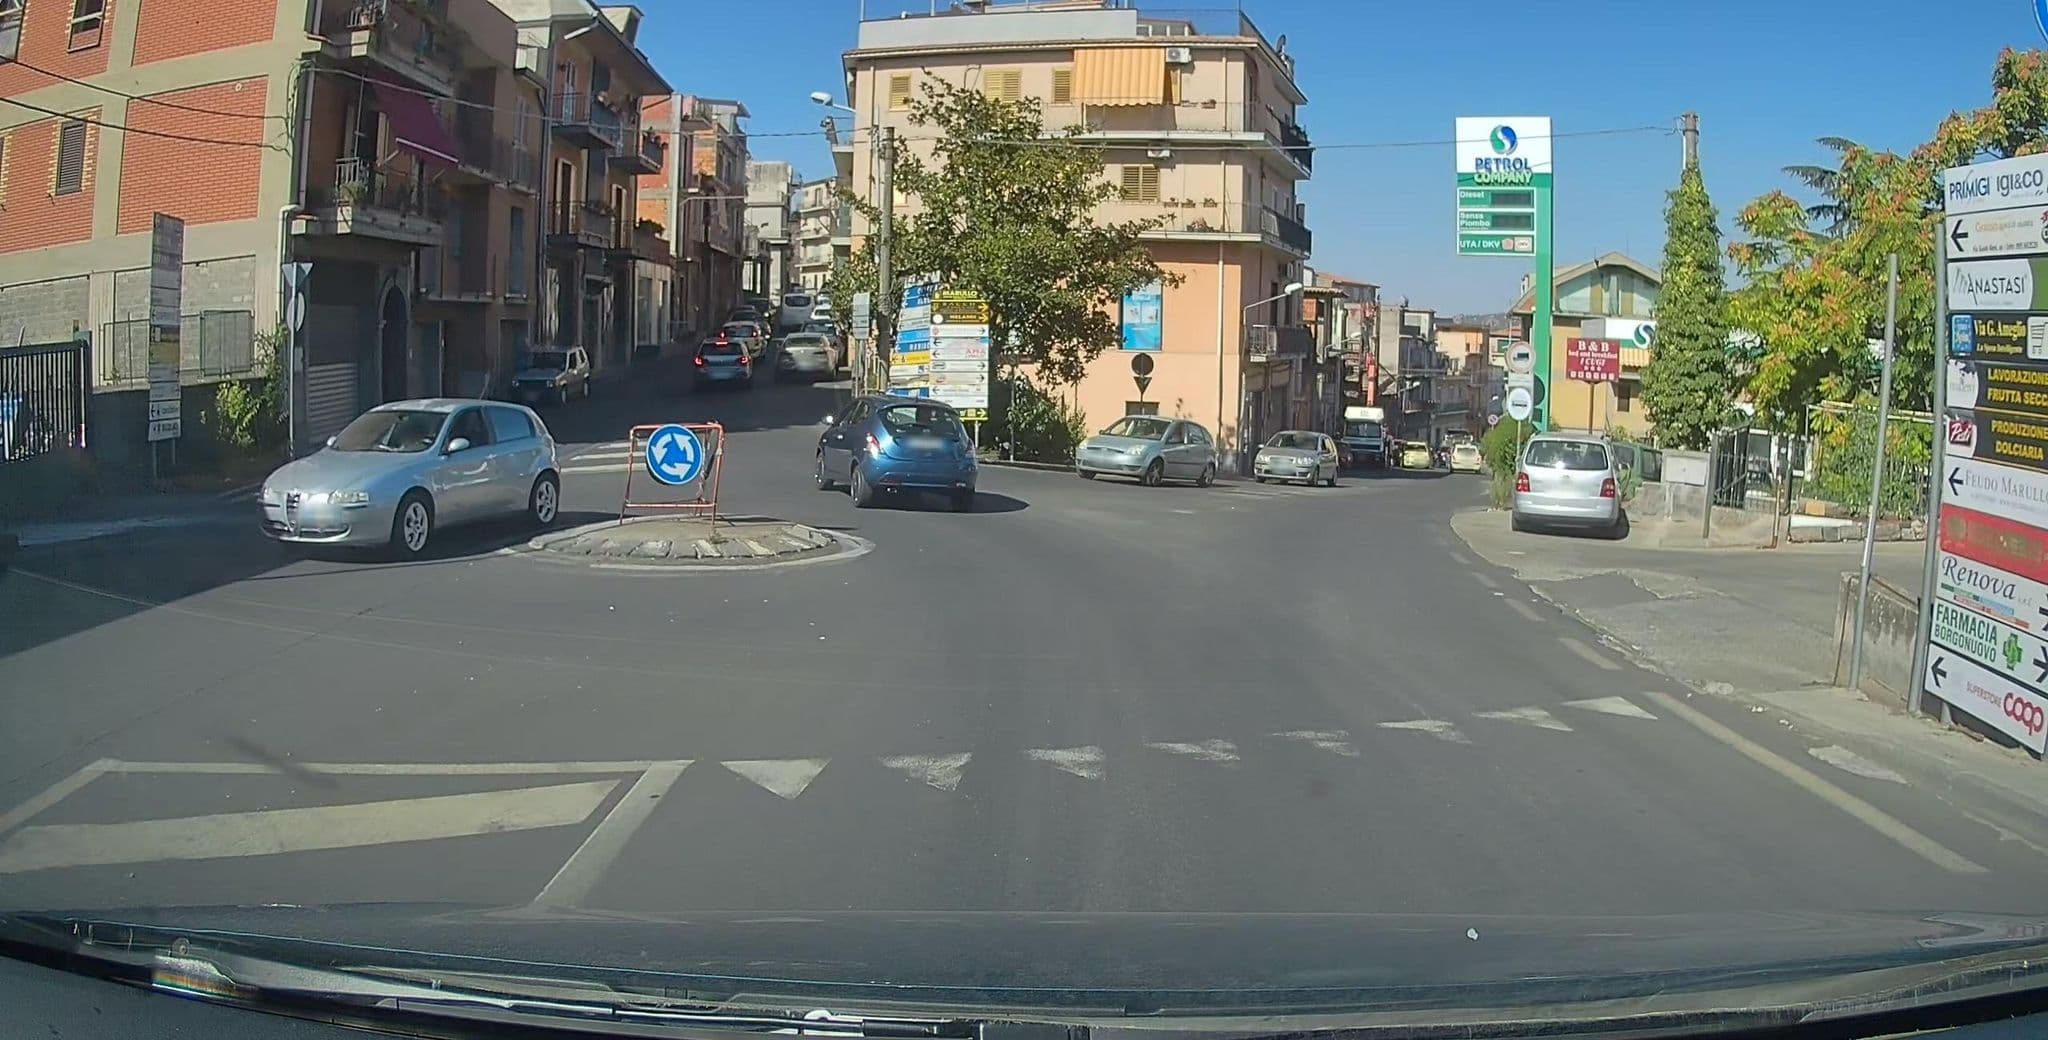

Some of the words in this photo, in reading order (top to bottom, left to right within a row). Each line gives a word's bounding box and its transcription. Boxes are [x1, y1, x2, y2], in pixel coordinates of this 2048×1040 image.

[1475, 157, 1531, 172] PETROL
[1474, 171, 1533, 185] COMPANY
[1459, 191, 1485, 199] Diesel
[1950, 176, 1990, 200] PRIMIGI
[1459, 211, 1484, 219] Senza
[1459, 219, 1491, 228] Piombo
[1459, 240, 1478, 248] UTA
[1482, 240, 1500, 249] DKV
[1967, 273, 2025, 304] ANASTASI
[1974, 319, 1986, 337] Via
[1986, 320, 1996, 337] G.
[1578, 341, 1586, 351] B
[1588, 341, 1599, 352] &
[1601, 342, 1609, 352] B
[1987, 368, 2048, 385] LAVORAZIONE
[1987, 387, 2022, 404] FRUTTA
[1991, 420, 2048, 440] PRODUZIONE
[1995, 441, 2044, 461] DOLCIARIA
[1965, 470, 1998, 492] FEUDO
[2001, 477, 2048, 503] MARULL
[1942, 556, 2016, 600] Renova
[1936, 604, 1998, 645] FARMACIA
[1934, 623, 1997, 662] BORGONUOVO
[2003, 692, 2044, 736] coop
